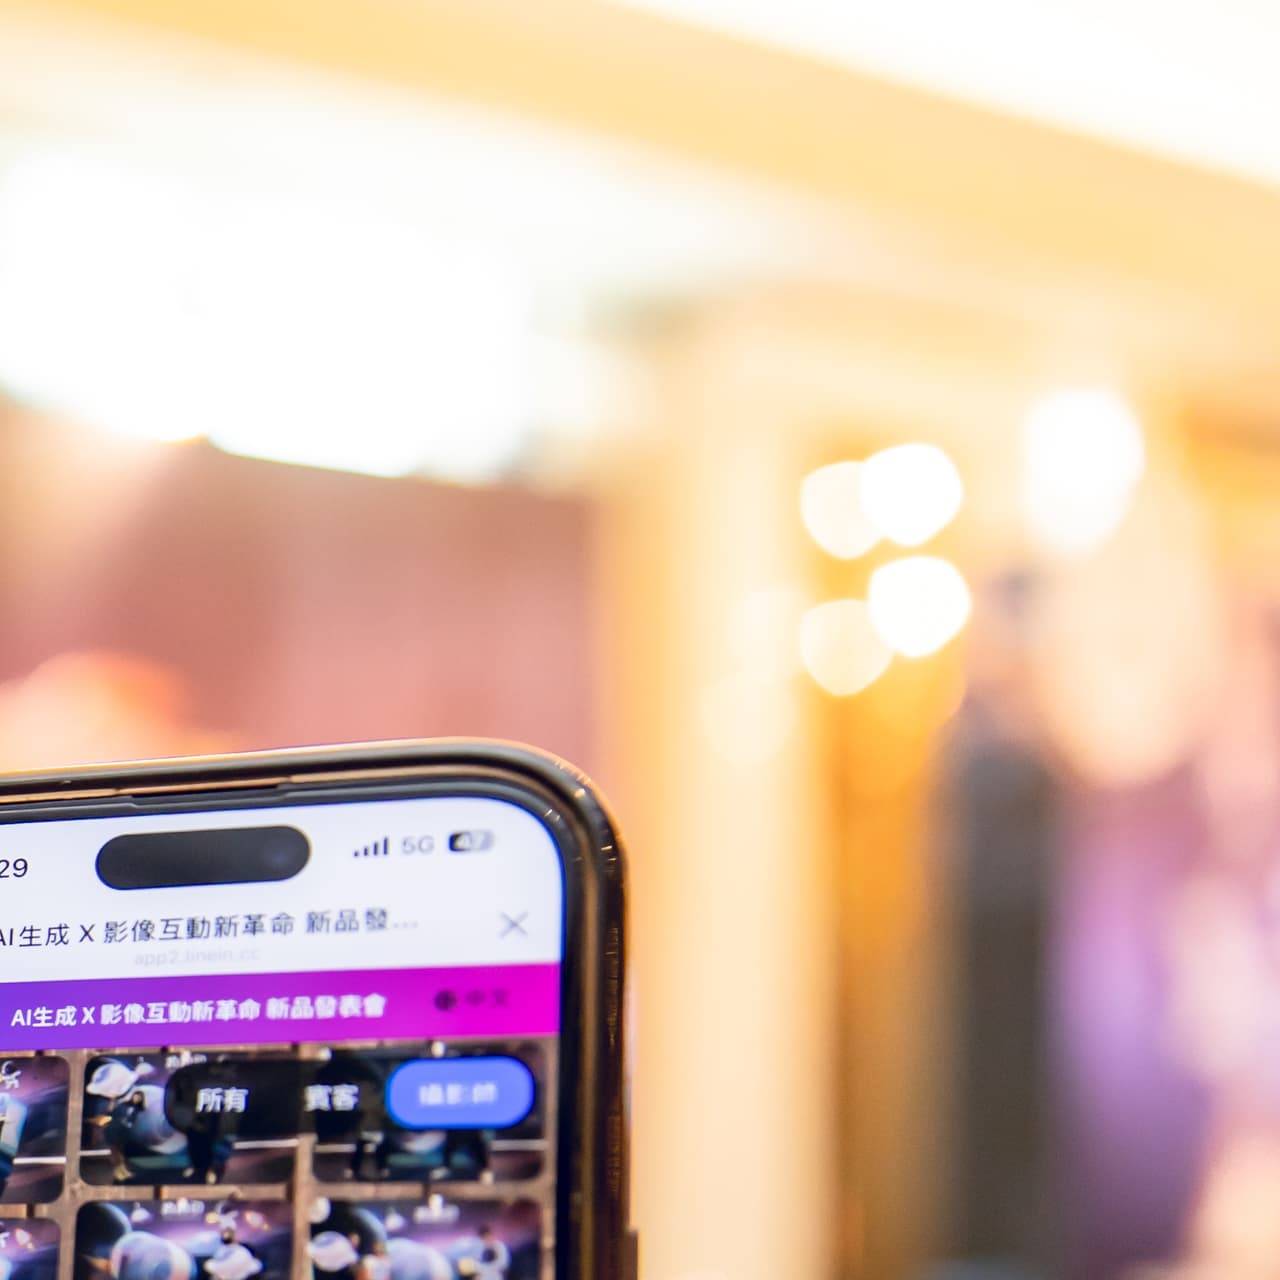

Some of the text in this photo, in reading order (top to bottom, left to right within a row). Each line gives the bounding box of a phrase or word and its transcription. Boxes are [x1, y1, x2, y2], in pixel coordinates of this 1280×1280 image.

[401, 835, 435, 855] 5G
[103, 912, 295, 944] 影像互動新革命
[10, 1005, 77, 1027] AI生成
[196, 1086, 249, 1113] 所有
